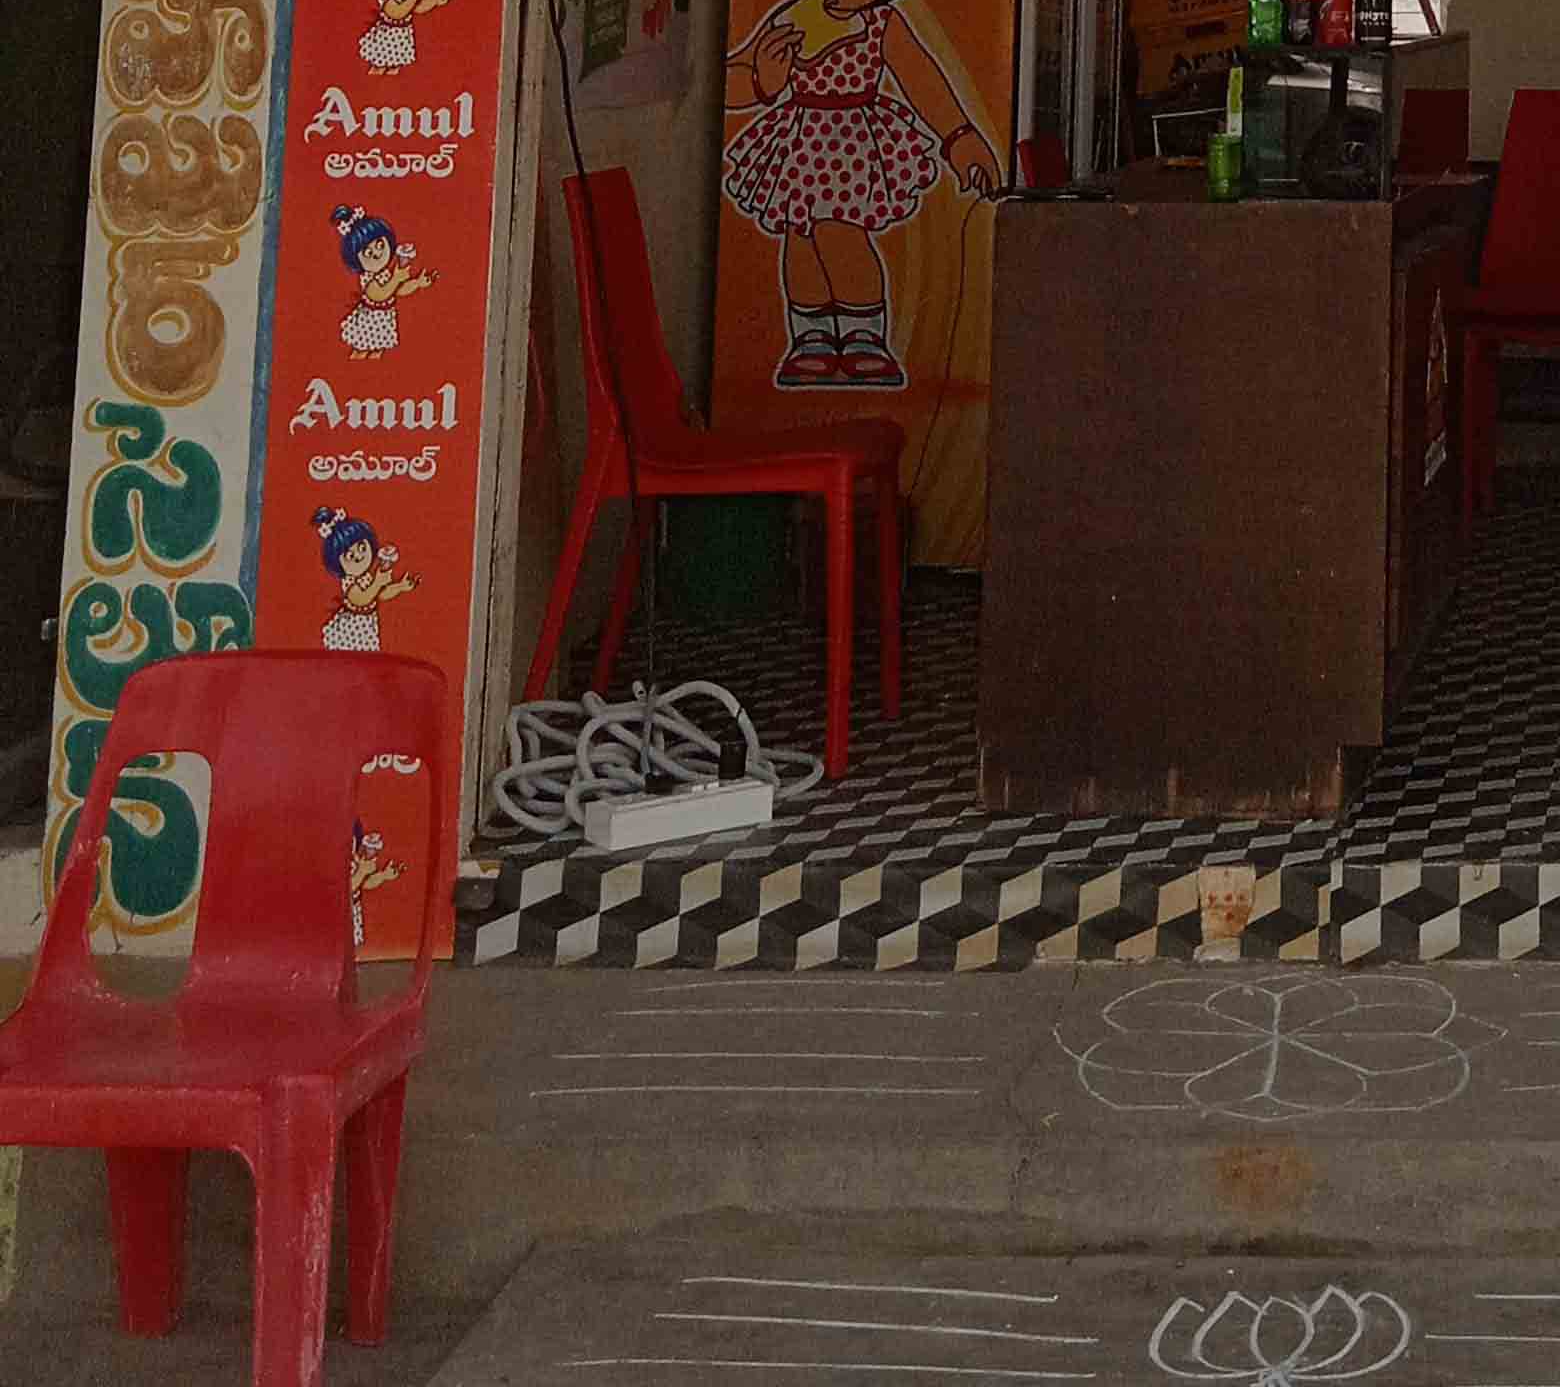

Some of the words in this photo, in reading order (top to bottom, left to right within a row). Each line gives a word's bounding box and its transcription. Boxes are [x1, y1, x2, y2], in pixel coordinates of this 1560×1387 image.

[304, 87, 475, 141] Amul
[323, 144, 459, 180] అమూల్
[290, 378, 459, 433] Amul
[307, 445, 441, 484] అమూల్
